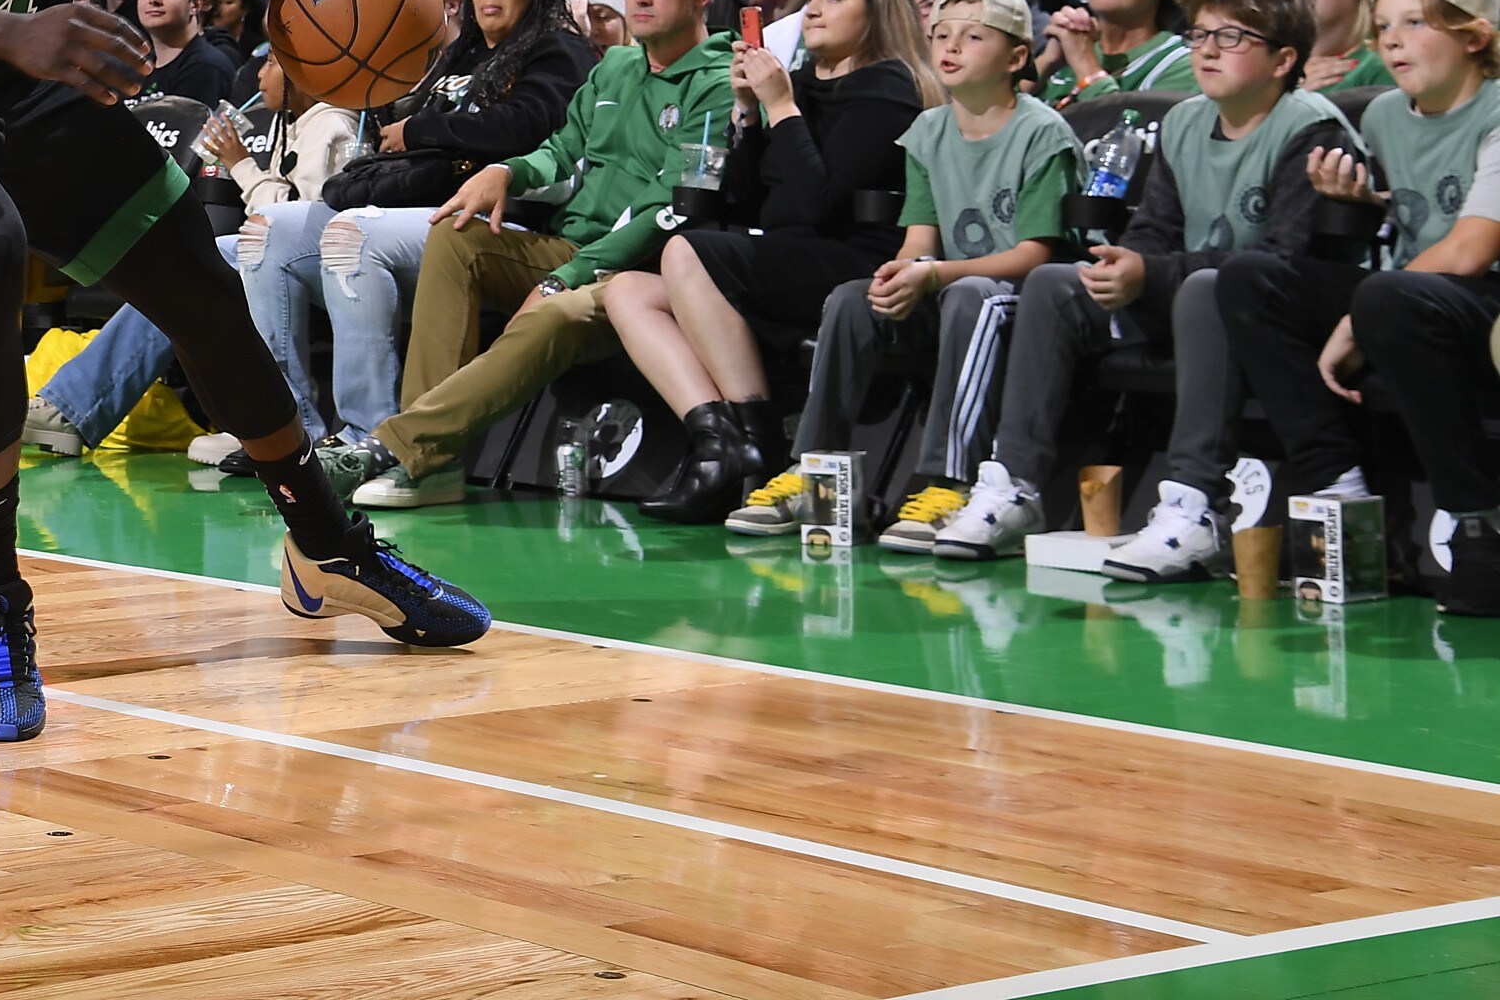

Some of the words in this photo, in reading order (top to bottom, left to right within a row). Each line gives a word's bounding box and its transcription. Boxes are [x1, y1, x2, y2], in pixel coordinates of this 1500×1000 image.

[838, 461, 848, 495] JAYSON
[838, 496, 849, 528] TATUM
[1327, 548, 1339, 582] TATUM
